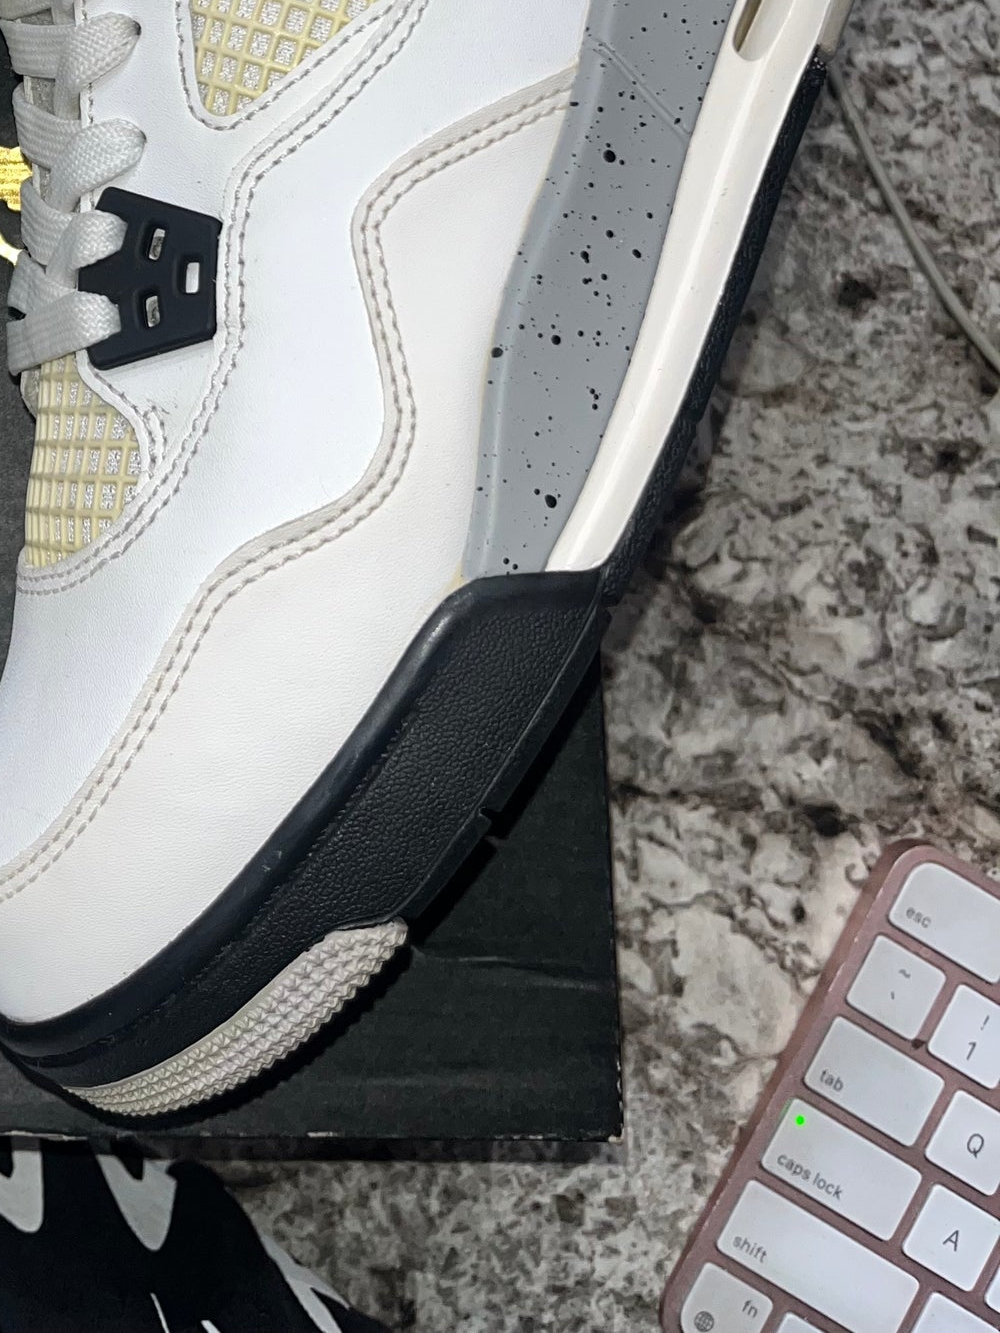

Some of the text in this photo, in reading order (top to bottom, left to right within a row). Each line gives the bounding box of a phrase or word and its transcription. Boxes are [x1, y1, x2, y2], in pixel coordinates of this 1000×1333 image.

[906, 906, 932, 929] esc
[980, 1015, 990, 1031] !
[966, 1041, 977, 1061] 1
[819, 1069, 844, 1093] tab
[966, 1133, 985, 1158] Q
[776, 1153, 843, 1200] caps lock
[732, 1234, 768, 1263] shift
[942, 1230, 960, 1252] A
[741, 1299, 758, 1318] fn
